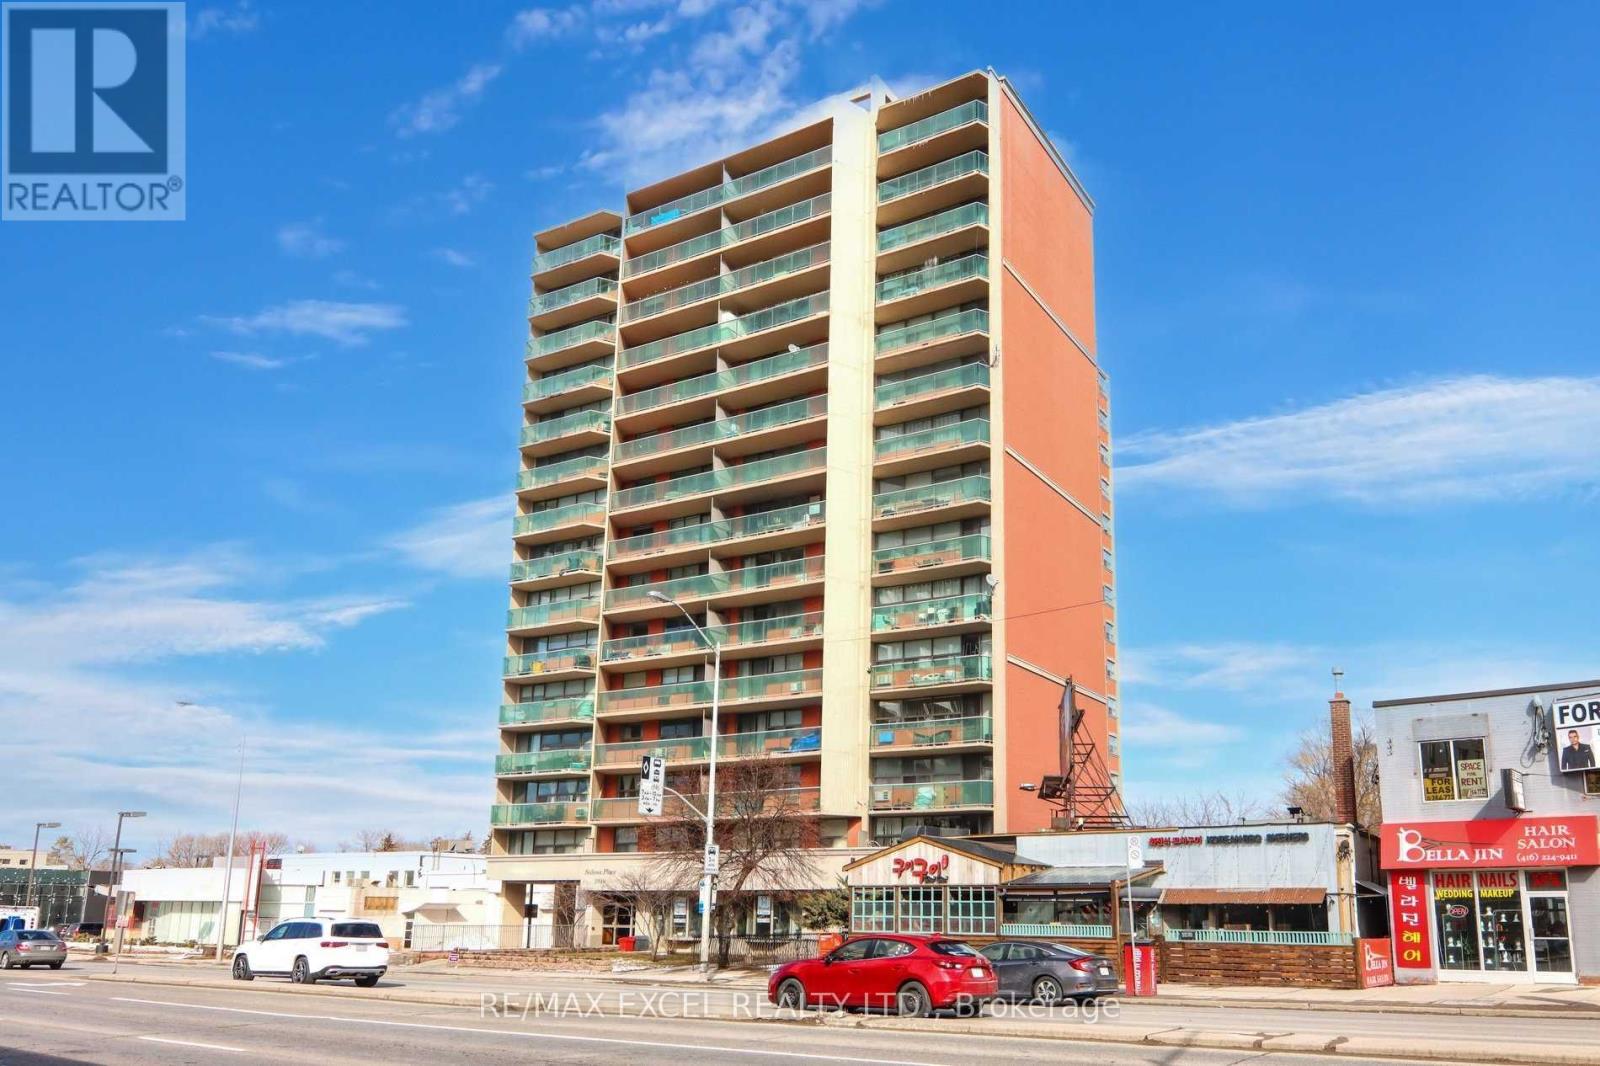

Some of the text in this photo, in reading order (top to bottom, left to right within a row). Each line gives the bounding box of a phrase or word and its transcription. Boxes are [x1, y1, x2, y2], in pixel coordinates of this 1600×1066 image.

[1558, 701, 1600, 725] FOR
[1460, 762, 1481, 771] SPACE
[1431, 777, 1451, 786] FOR
[1461, 777, 1483, 786] RENT
[1525, 824, 1570, 837] HAIR
[1396, 827, 1504, 864] BELLA JIN
[1517, 837, 1576, 849] SALON
[1516, 852, 1539, 863] (416)
[1434, 873, 1473, 888] HAIR
[1480, 872, 1518, 887] NAILS
[1434, 889, 1514, 899] WEDDING MAKEUP
